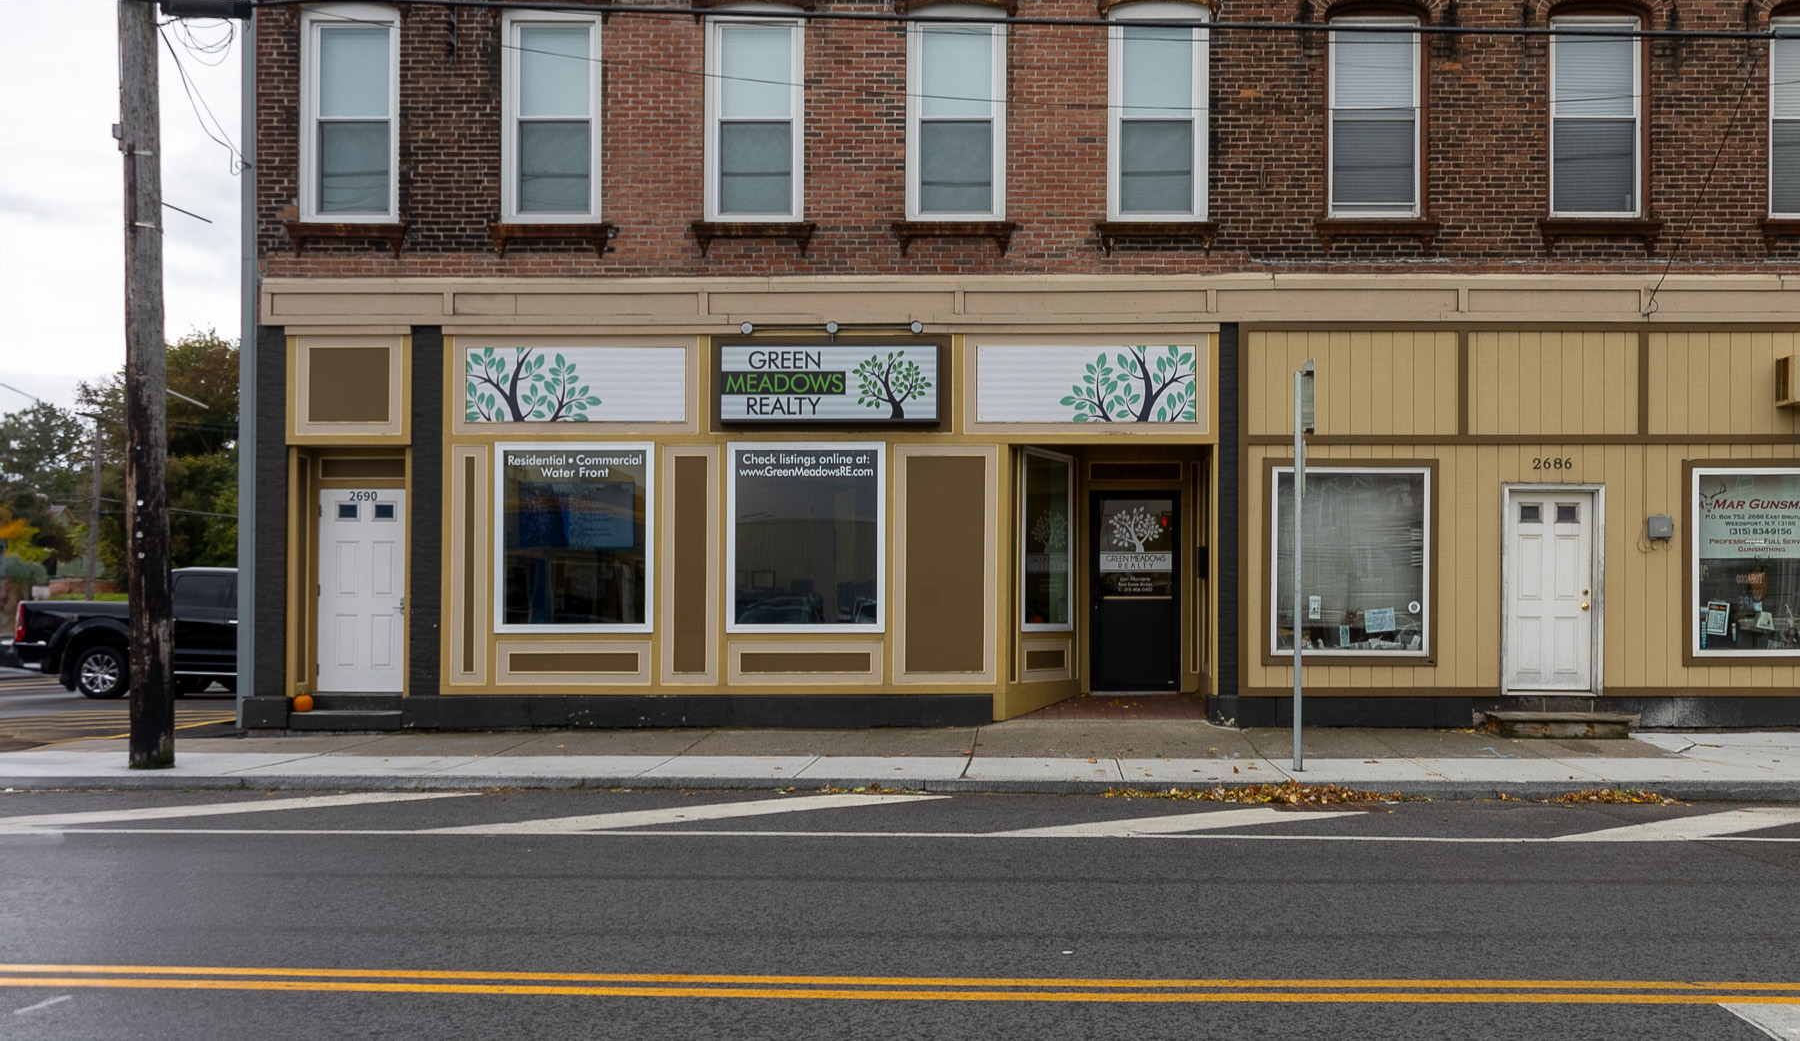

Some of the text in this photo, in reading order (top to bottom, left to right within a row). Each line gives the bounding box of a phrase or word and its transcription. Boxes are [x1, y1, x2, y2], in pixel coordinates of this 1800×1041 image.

[748, 351, 821, 369] GREEN
[725, 373, 844, 393] MEADOWS
[746, 397, 821, 415] REALTY
[507, 454, 642, 466] Residential Commercial
[742, 453, 870, 467] Check listings online at:
[1532, 457, 1572, 469] 2686
[541, 467, 609, 478] Water Front
[739, 466, 874, 477] www.GreenMeadowsRE.com
[349, 491, 378, 501] 2690
[1713, 499, 1746, 509] MAR
[1729, 528, 1750, 536] (315)
